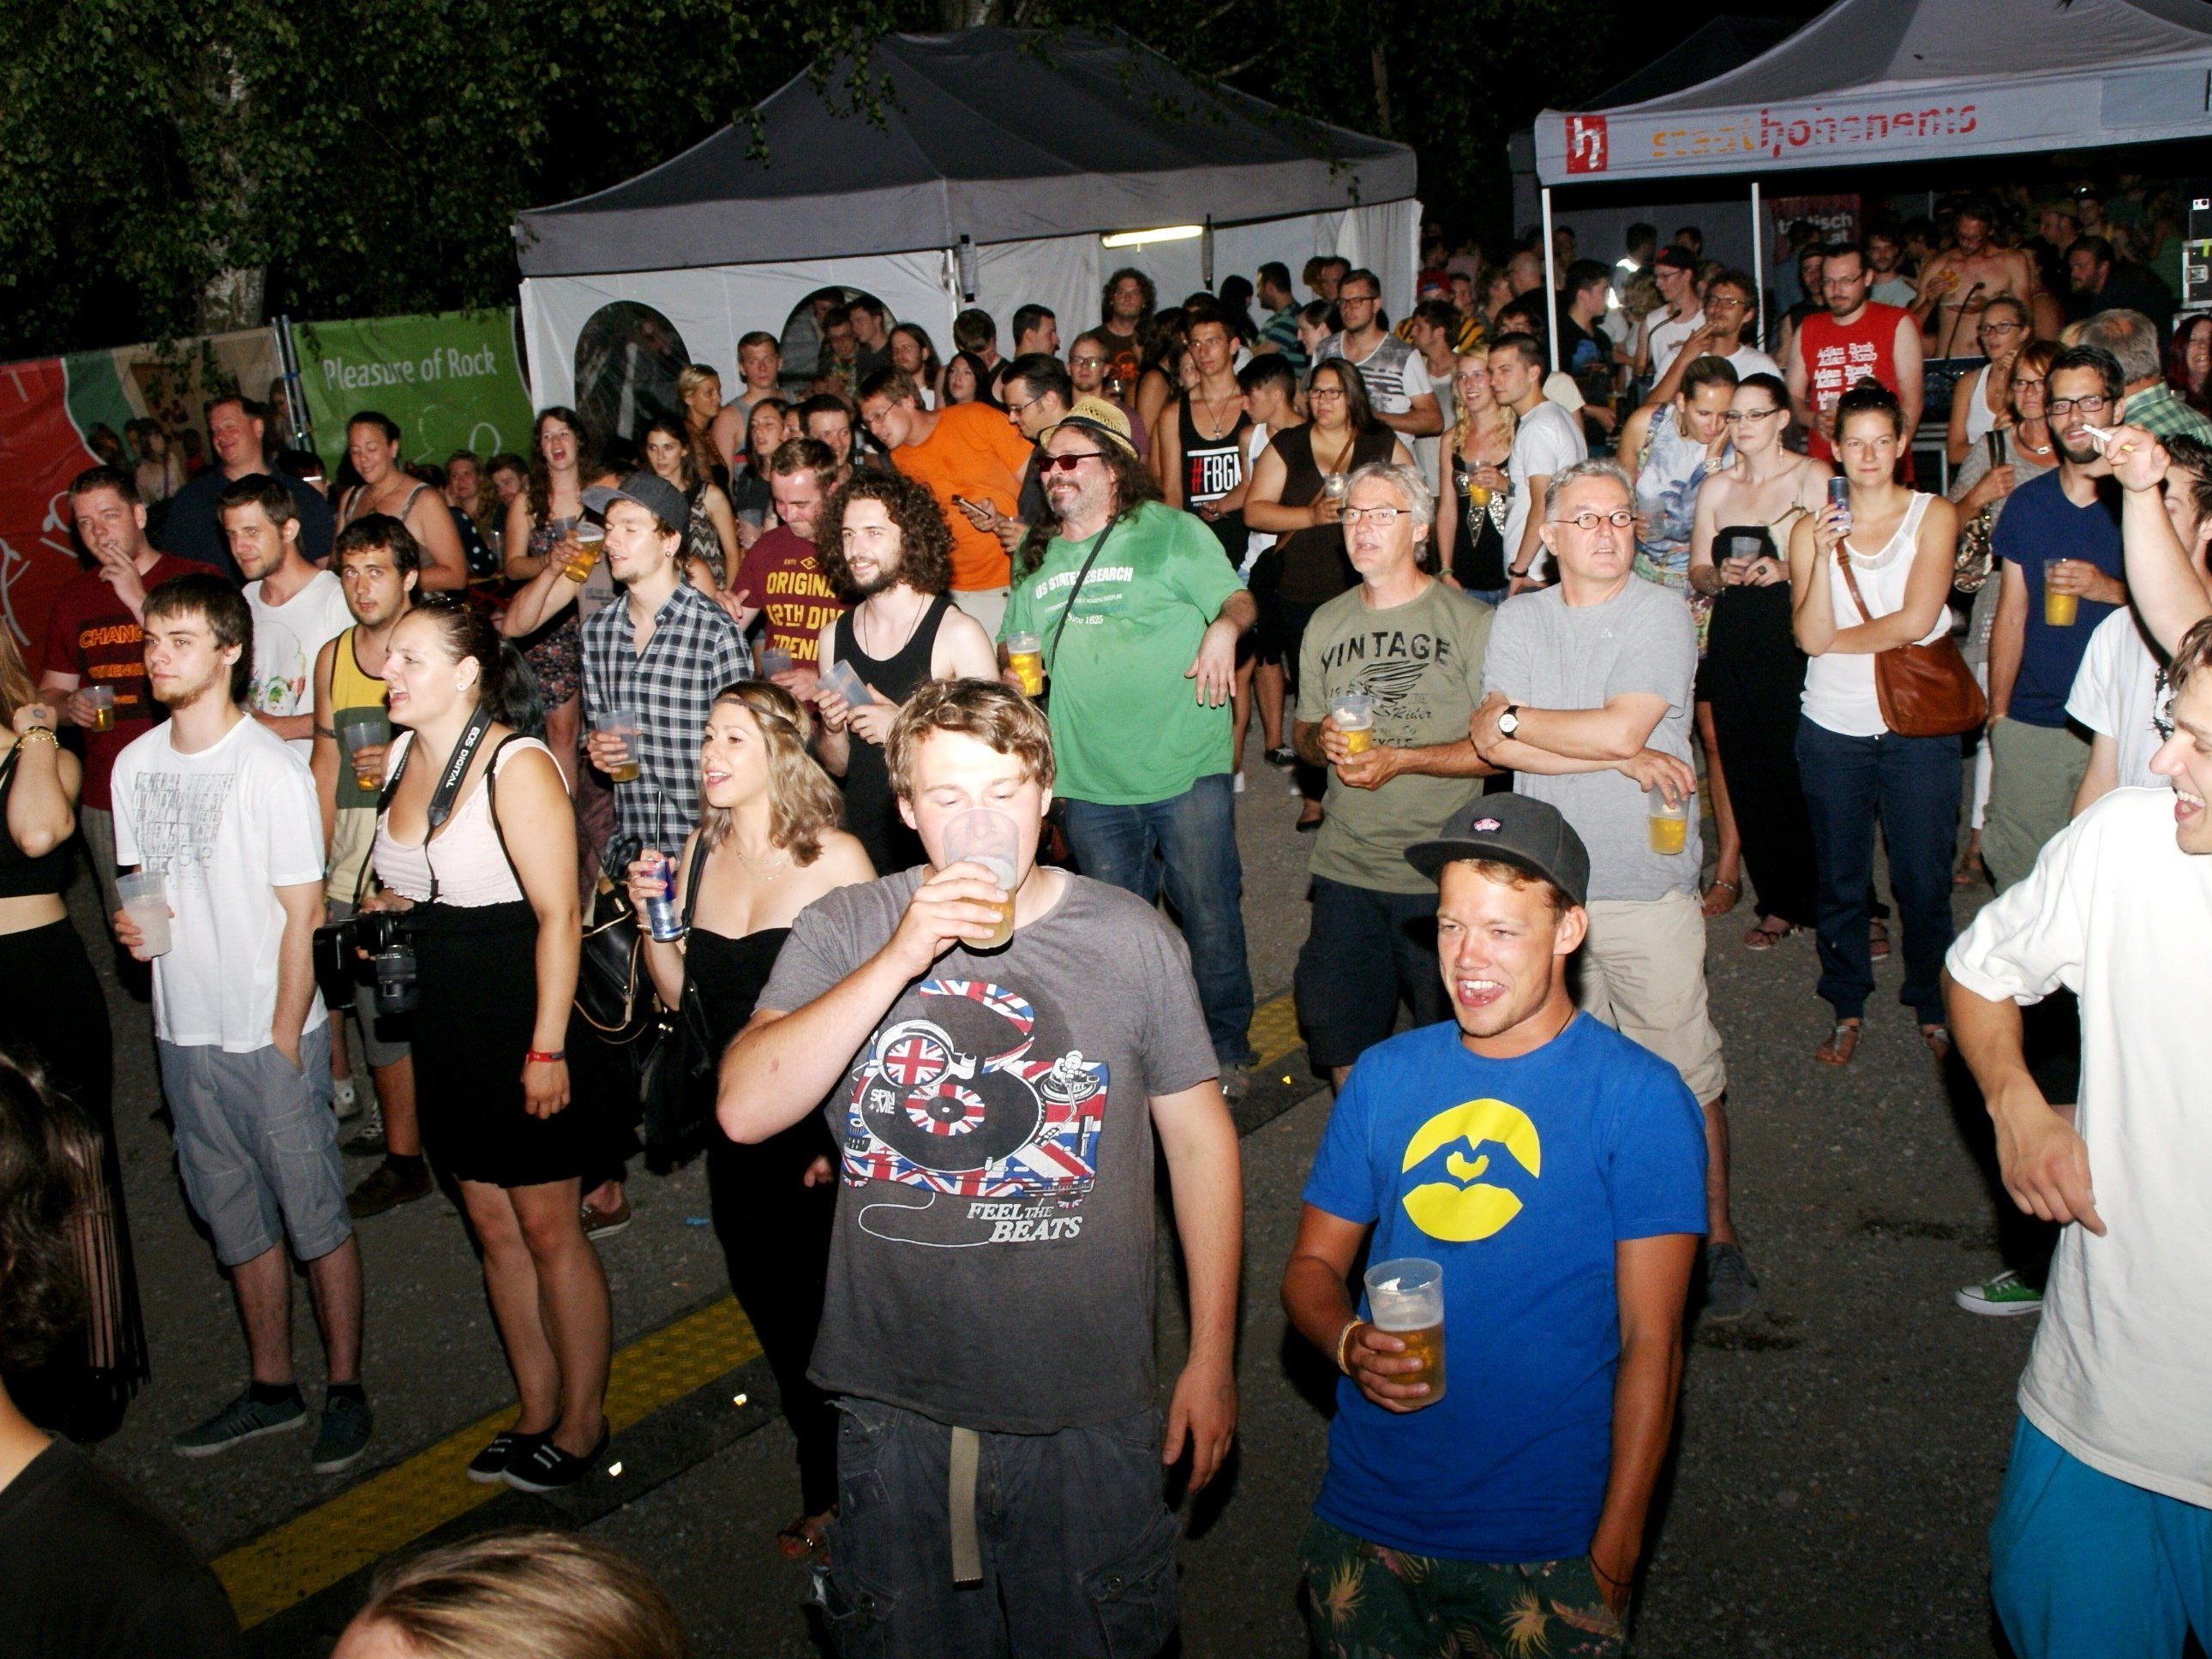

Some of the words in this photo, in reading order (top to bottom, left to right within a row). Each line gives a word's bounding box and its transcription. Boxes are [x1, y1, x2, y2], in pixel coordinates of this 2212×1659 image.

[322, 356, 414, 391] Pleasure
[420, 347, 443, 382] of
[447, 343, 497, 379] Rock
[1035, 581, 1048, 599] US
[1077, 566, 1133, 585] ESEARCH
[1321, 631, 1451, 674] VINTAGE
[465, 726, 481, 748] EOS
[445, 748, 470, 788] DIGITAL
[966, 1202, 1024, 1220] FEEL
[1024, 1205, 1055, 1219] THE
[988, 1215, 1083, 1243] BEATS
